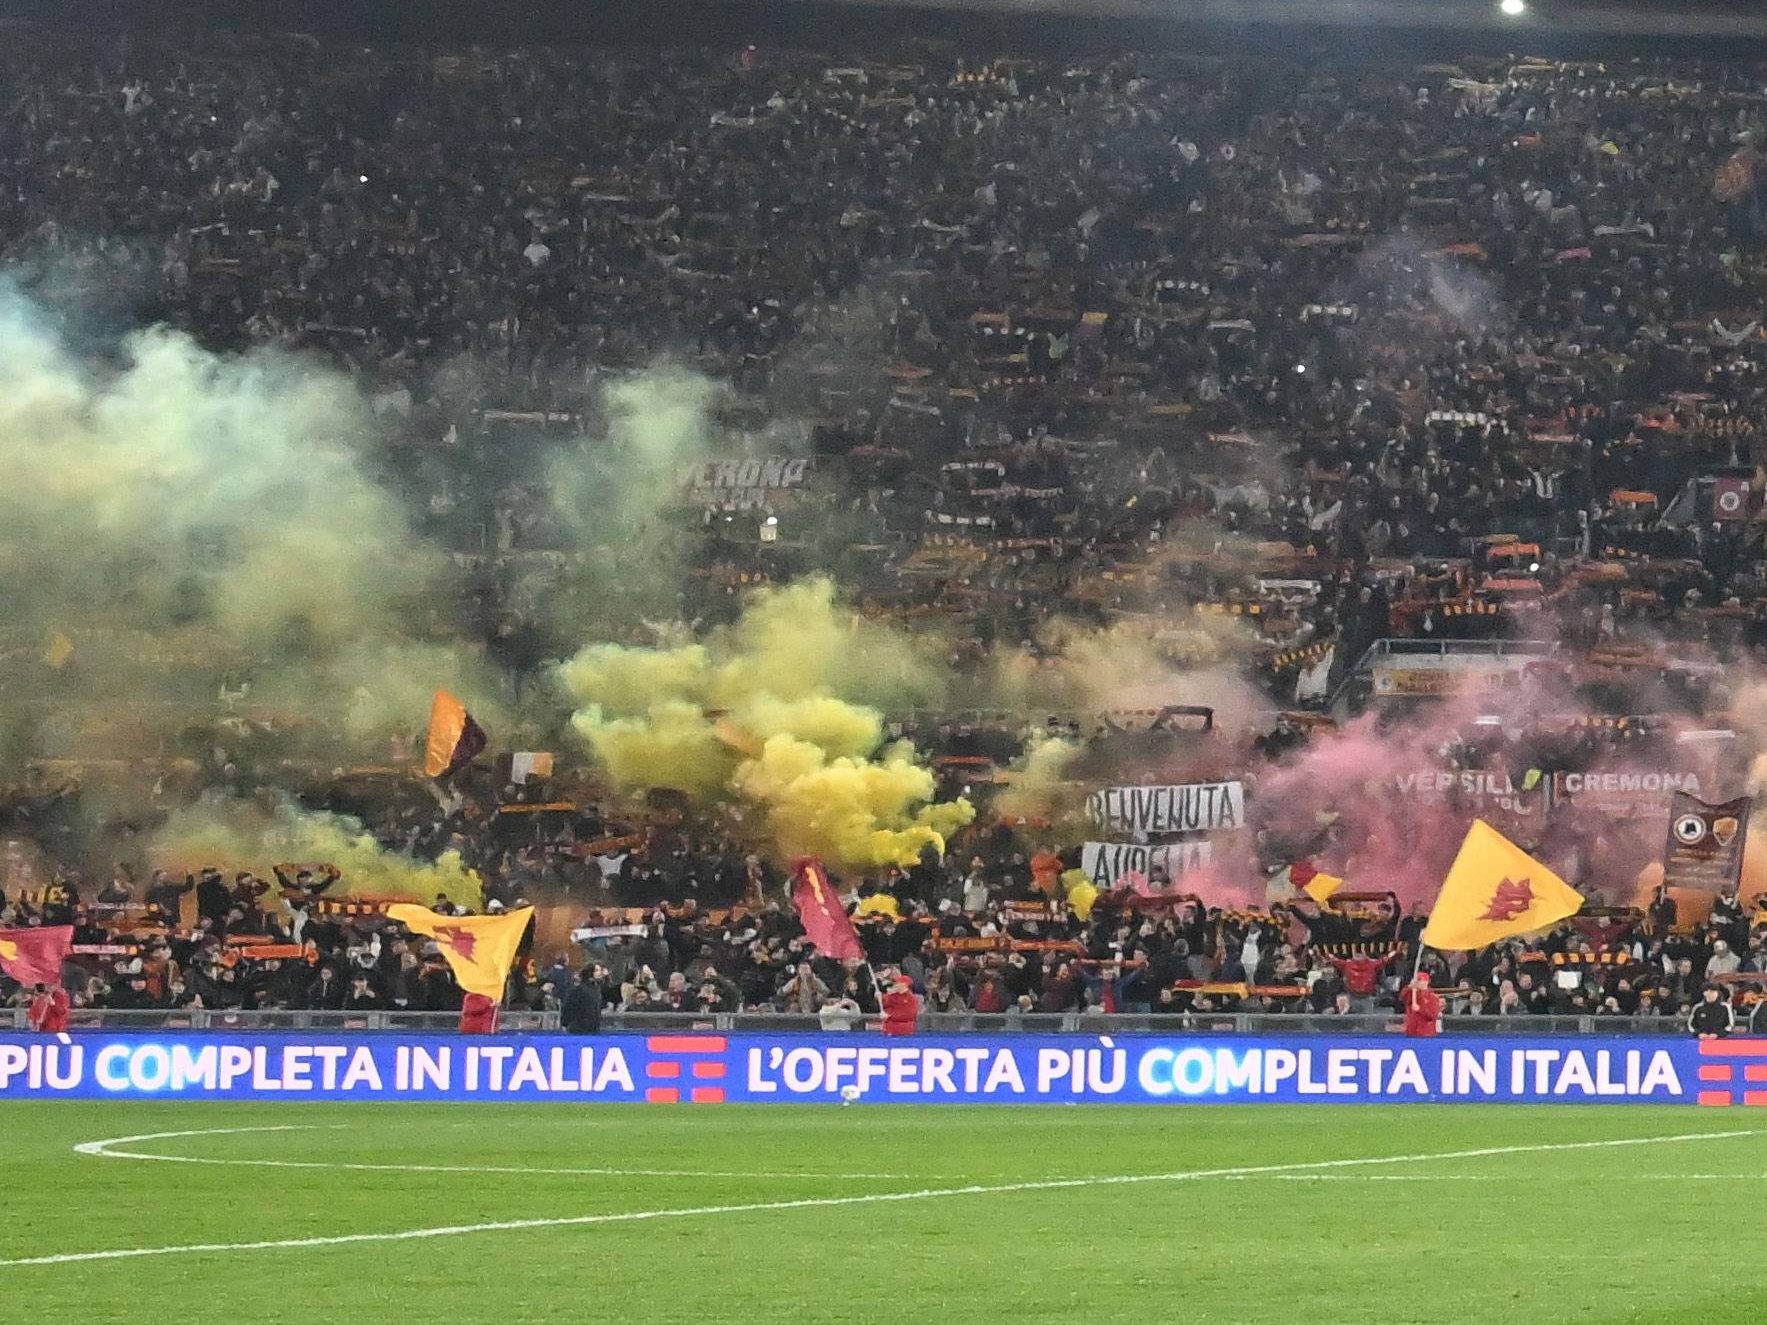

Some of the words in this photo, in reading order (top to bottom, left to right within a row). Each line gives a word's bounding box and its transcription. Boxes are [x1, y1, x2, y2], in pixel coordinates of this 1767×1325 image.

[1565, 773, 1700, 792] CREMONA
[1088, 786, 1237, 831] BENVENUTA
[96, 1045, 382, 1091] COMPLETA
[396, 1046, 451, 1091] IN
[465, 1046, 635, 1092] ITALIA
[749, 1047, 1025, 1093] L'OFFERTA
[1038, 1036, 1127, 1094] PIÙ
[1139, 1048, 1429, 1095] COMPLETA
[1441, 1049, 1497, 1095] IN
[1511, 1049, 1682, 1095] ITALIA
